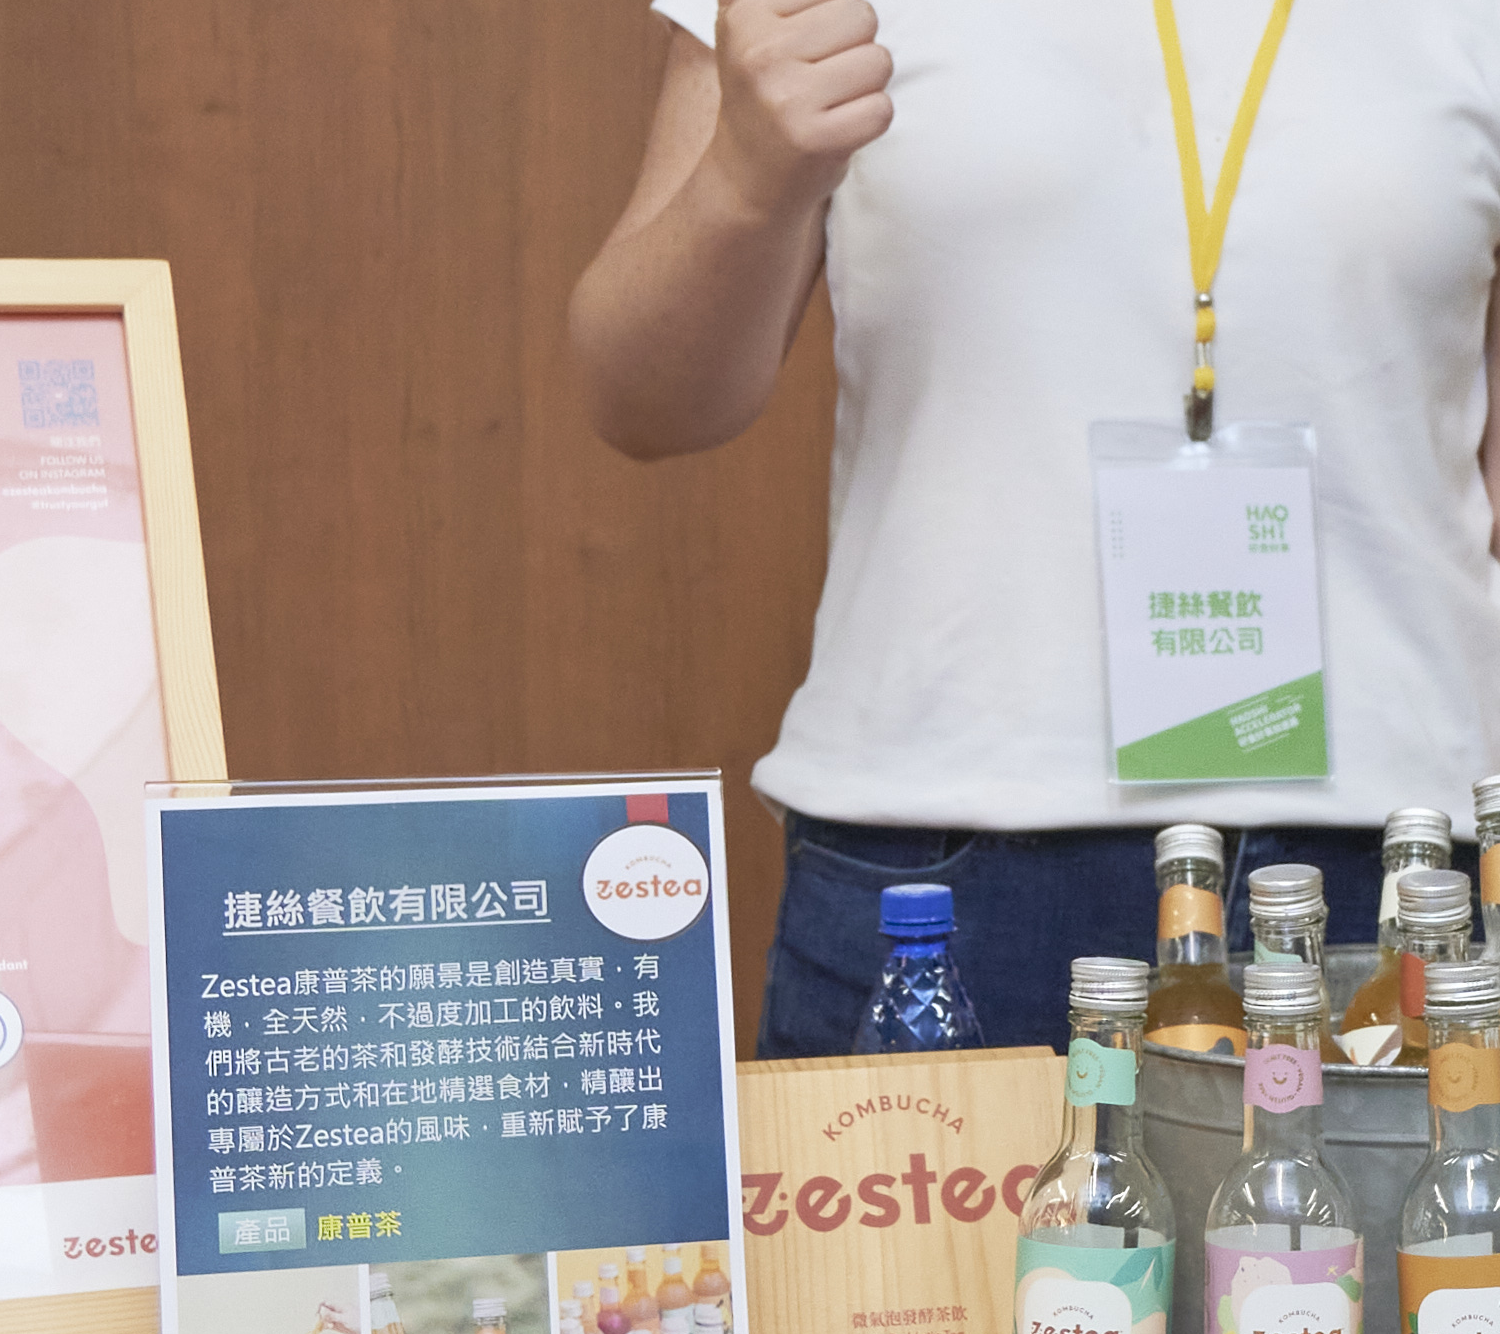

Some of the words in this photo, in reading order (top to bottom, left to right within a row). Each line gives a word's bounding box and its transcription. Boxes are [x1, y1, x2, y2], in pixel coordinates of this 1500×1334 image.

[41, 455, 86, 465] FOLLOW
[41, 469, 105, 479] INSTAGRAM
[1246, 504, 1288, 522] HAO
[1149, 591, 1263, 618] 捷絲餐飲
[1151, 627, 1263, 656] 有限公司
[596, 874, 702, 900] zestea
[223, 879, 549, 929] 捷絲餐飲有限公司
[205, 1029, 661, 1078] 們將古老的茶和發酵技術結合新時代
[821, 1093, 966, 1143] KOMBUCHA
[209, 1157, 403, 1193] 普茶新的定義。
[234, 1215, 291, 1244] 產品
[316, 1211, 402, 1241] 康普茶
[63, 1229, 157, 1259] zeste
[852, 1305, 968, 1329] 微氣泡發酵茶飲
[1053, 1305, 1094, 1320] KOMBUCHA
[1279, 1309, 1320, 1323] KOMBUCHA
[1452, 1314, 1494, 1328] KOMBUCHA
